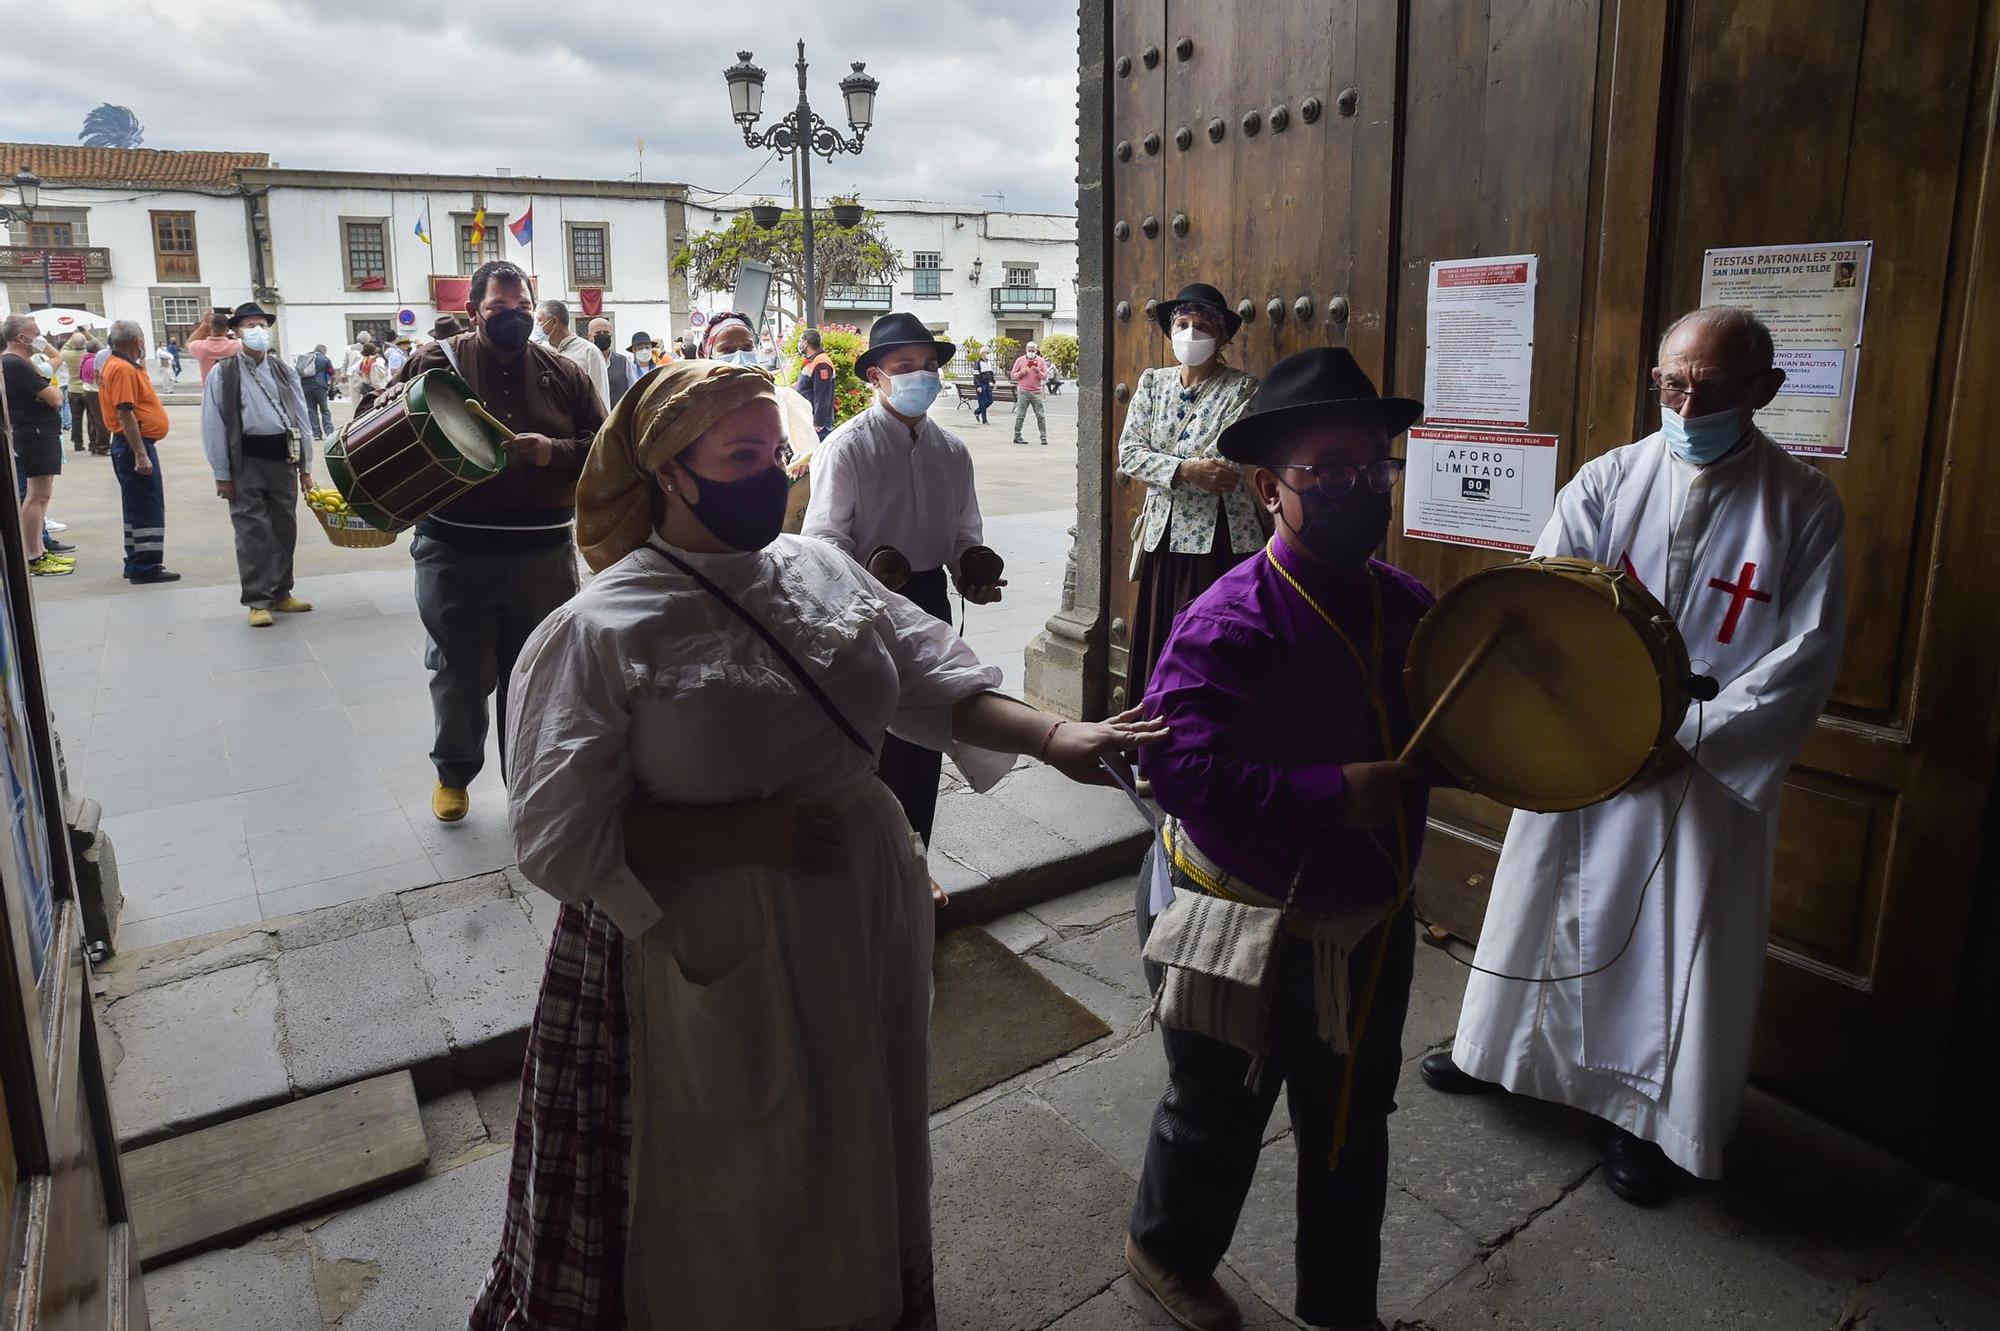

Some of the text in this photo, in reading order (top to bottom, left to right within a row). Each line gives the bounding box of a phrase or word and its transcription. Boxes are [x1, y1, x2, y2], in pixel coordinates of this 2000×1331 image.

[1713, 251, 1857, 266] FIESTAS PATRONALES 2021
[1751, 266, 1793, 274] BAUTISTA
[1447, 449, 1502, 462] AFORO
[1435, 462, 1515, 478] LIMITADO
[1468, 479, 1482, 489] 90
